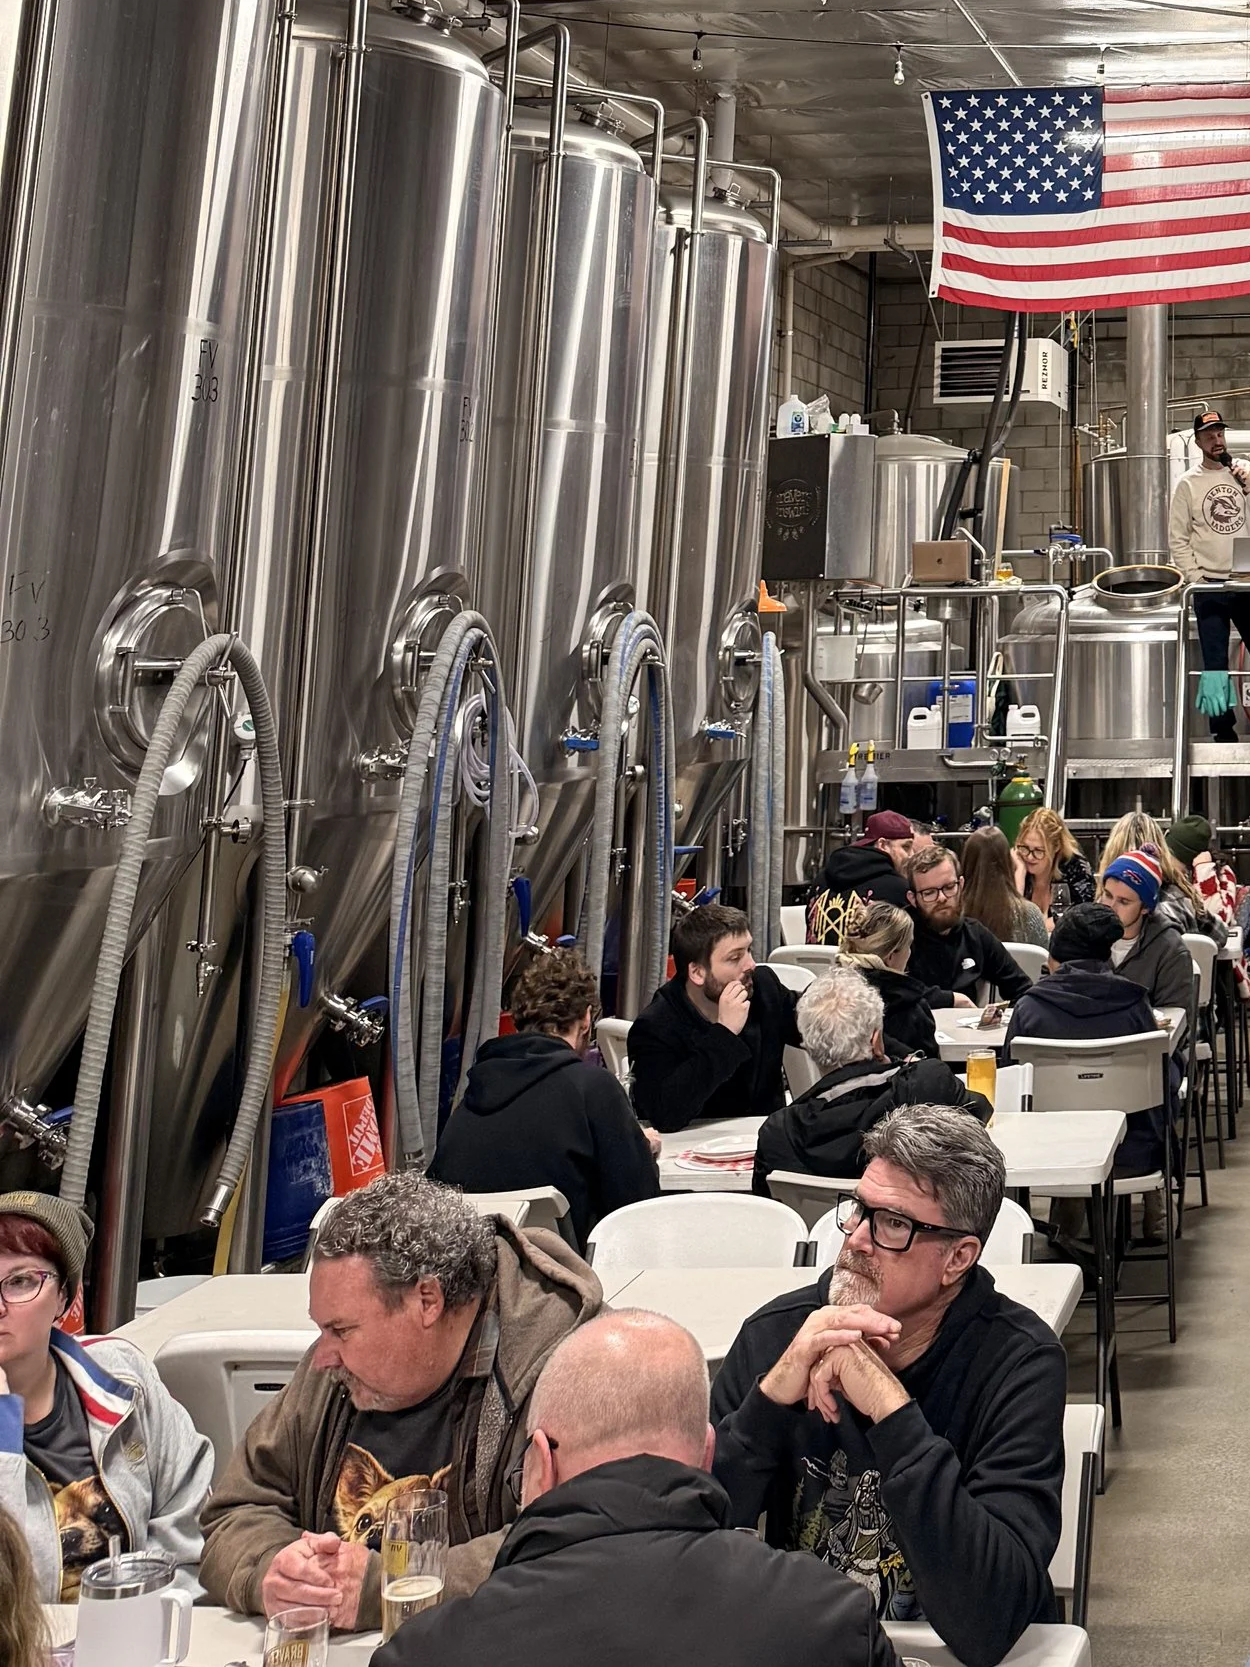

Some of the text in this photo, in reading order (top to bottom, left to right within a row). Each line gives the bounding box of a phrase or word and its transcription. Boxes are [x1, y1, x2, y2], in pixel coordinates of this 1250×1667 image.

[198, 338, 219, 370] FV
[1041, 350, 1049, 390] REZNOR
[191, 373, 219, 403] 303
